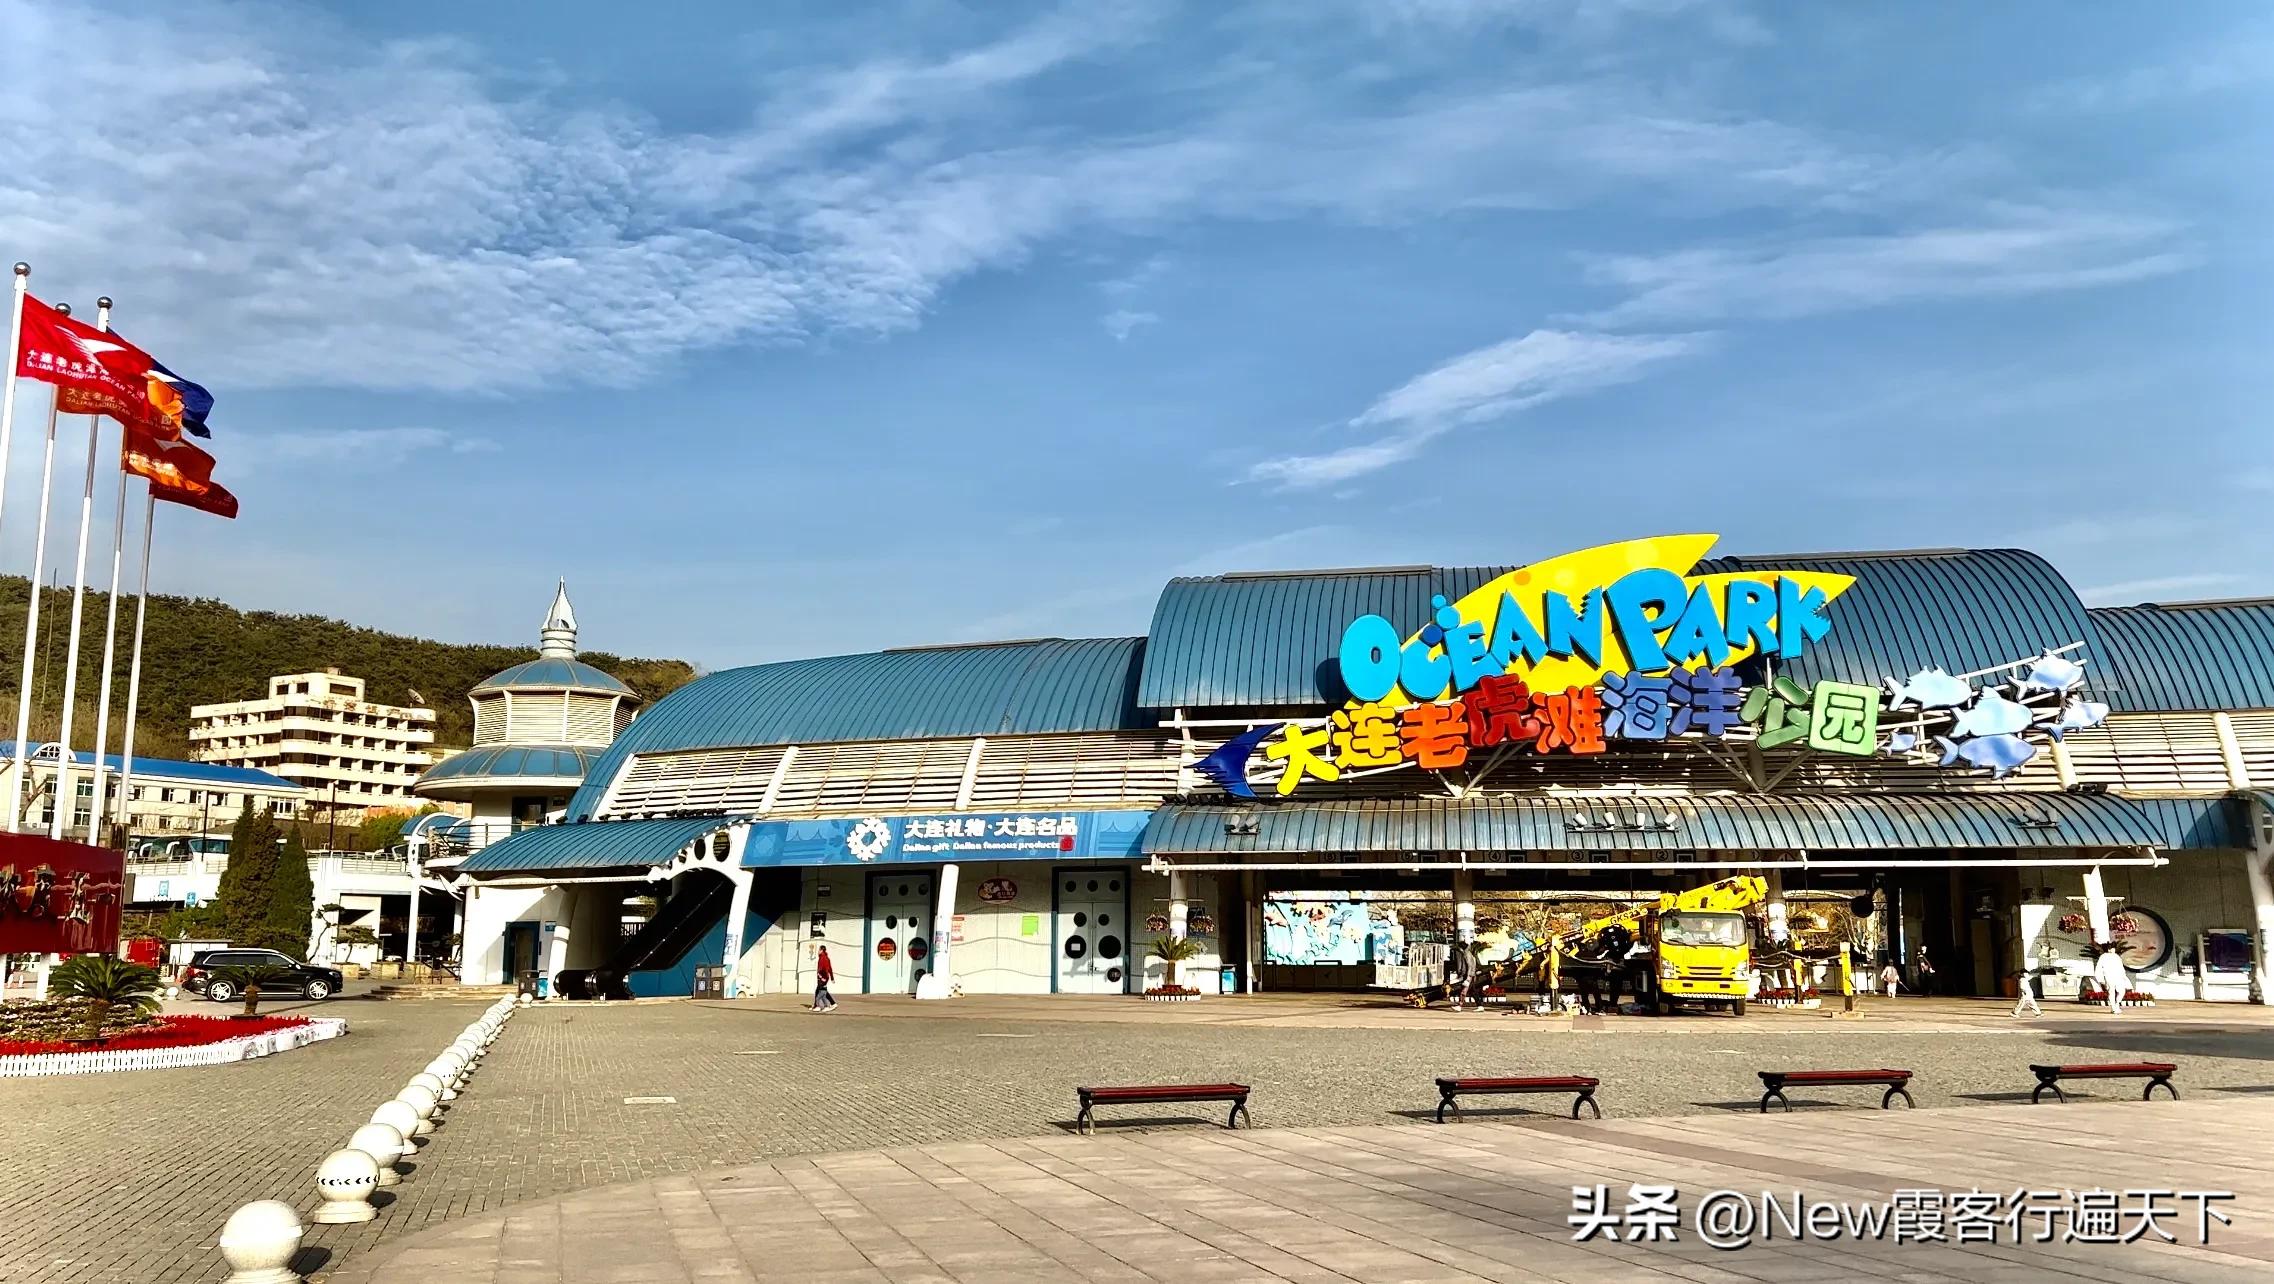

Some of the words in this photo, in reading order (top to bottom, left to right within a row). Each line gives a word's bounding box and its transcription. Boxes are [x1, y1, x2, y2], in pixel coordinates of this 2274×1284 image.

[1338, 587, 1602, 701] OCEAN
[1604, 568, 1833, 672] PARK
[1266, 666, 1879, 796] 大连老虎滩海洋公园
